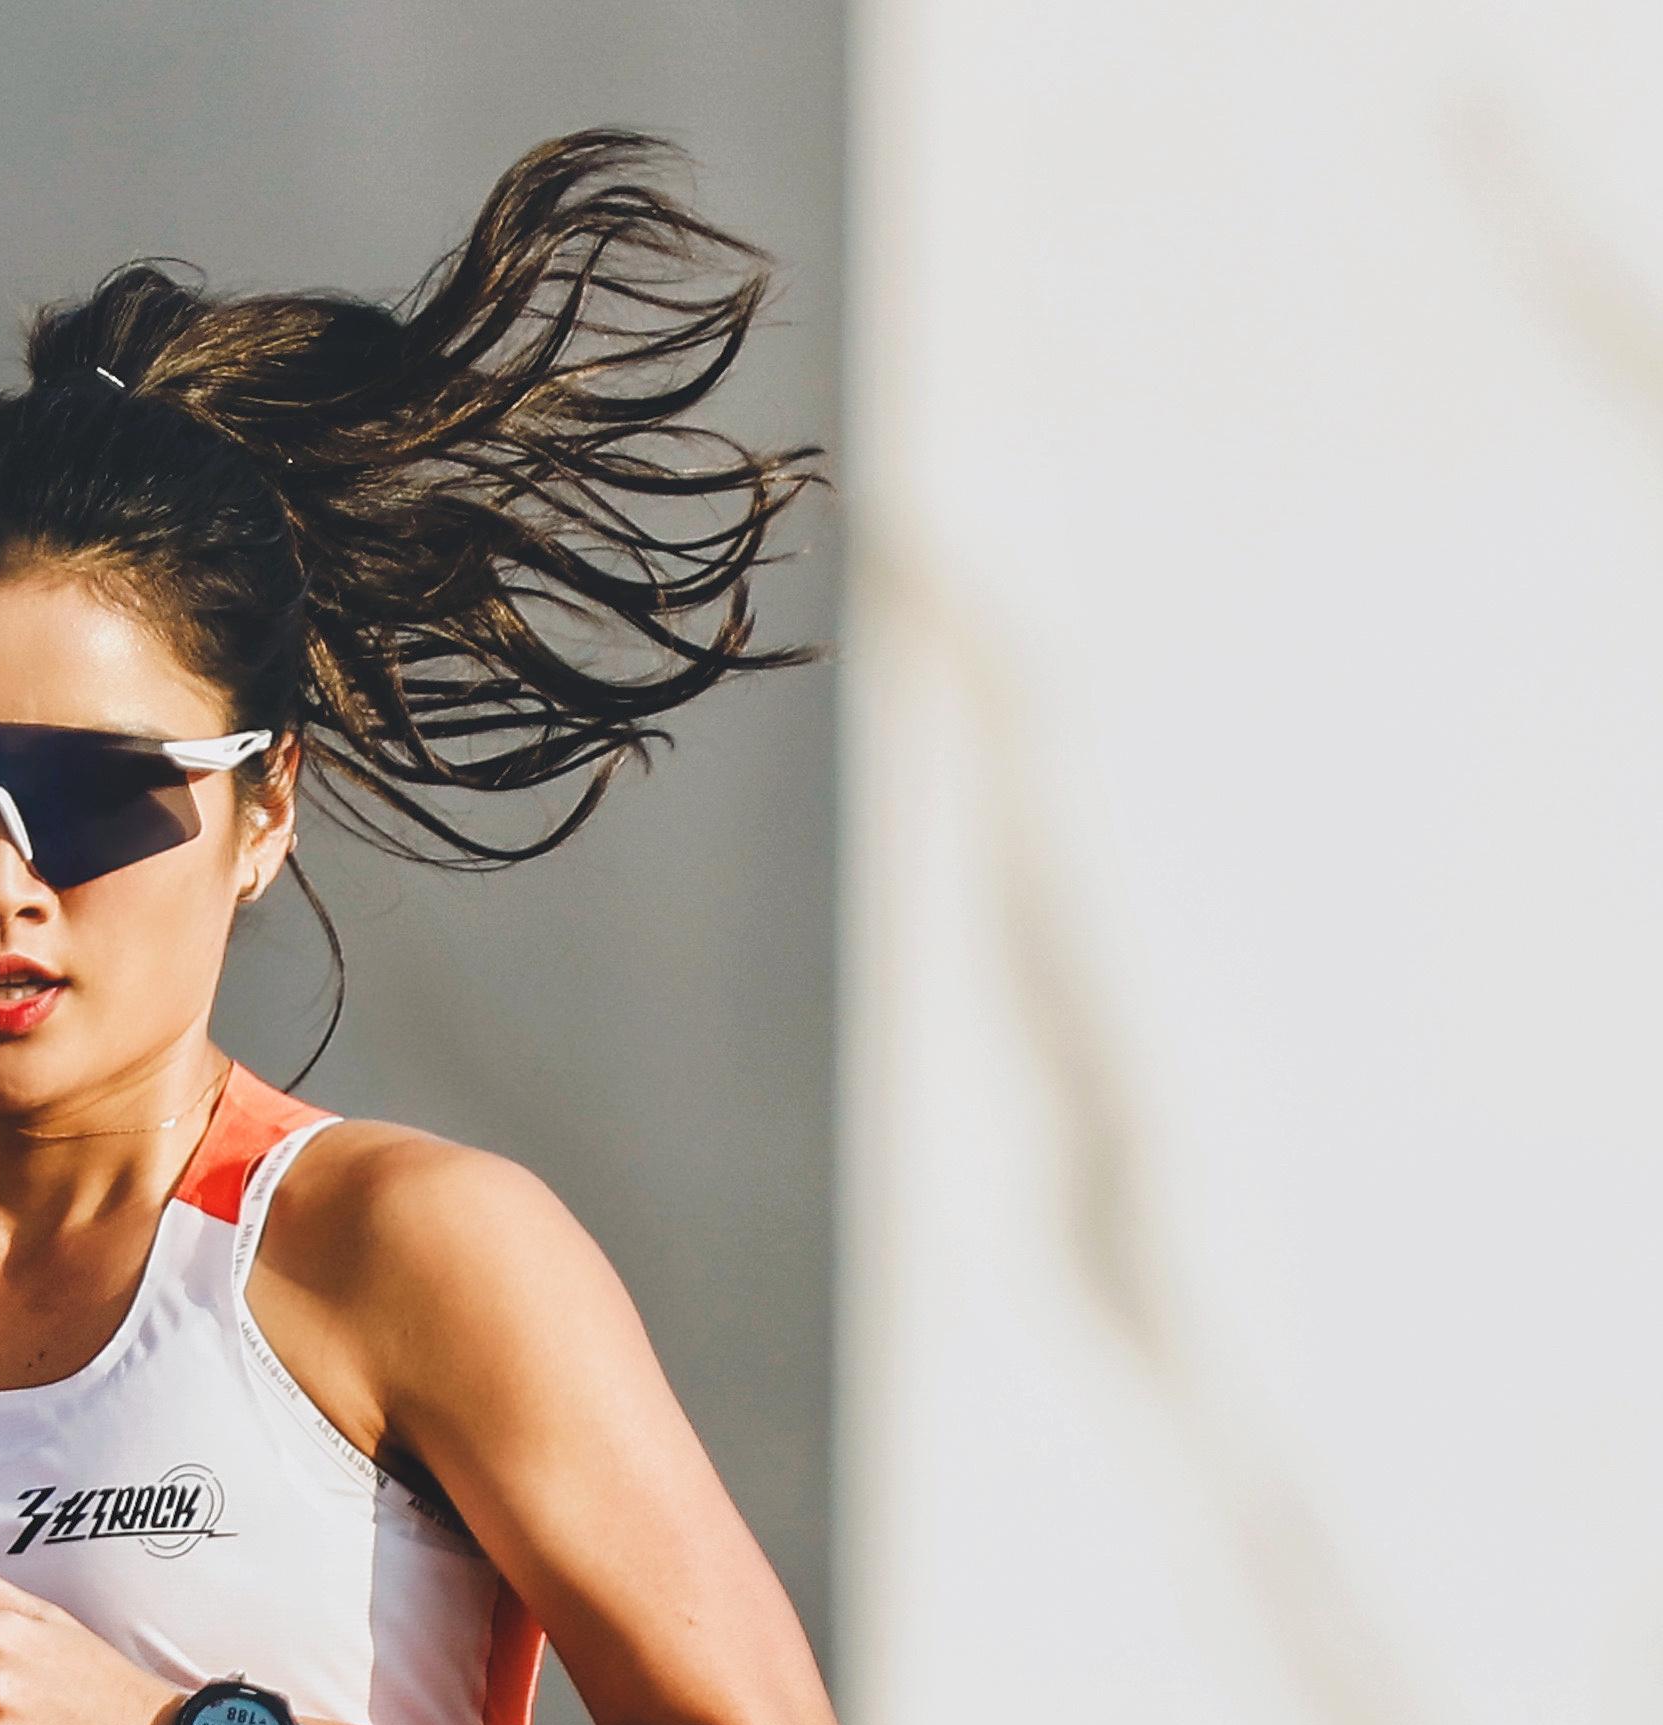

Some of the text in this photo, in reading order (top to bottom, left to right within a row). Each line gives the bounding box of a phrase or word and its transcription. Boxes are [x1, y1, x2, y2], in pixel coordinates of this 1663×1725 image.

[255, 1348, 300, 1401] LEISURE
[314, 1417, 391, 1491] ARIA LEISURE
